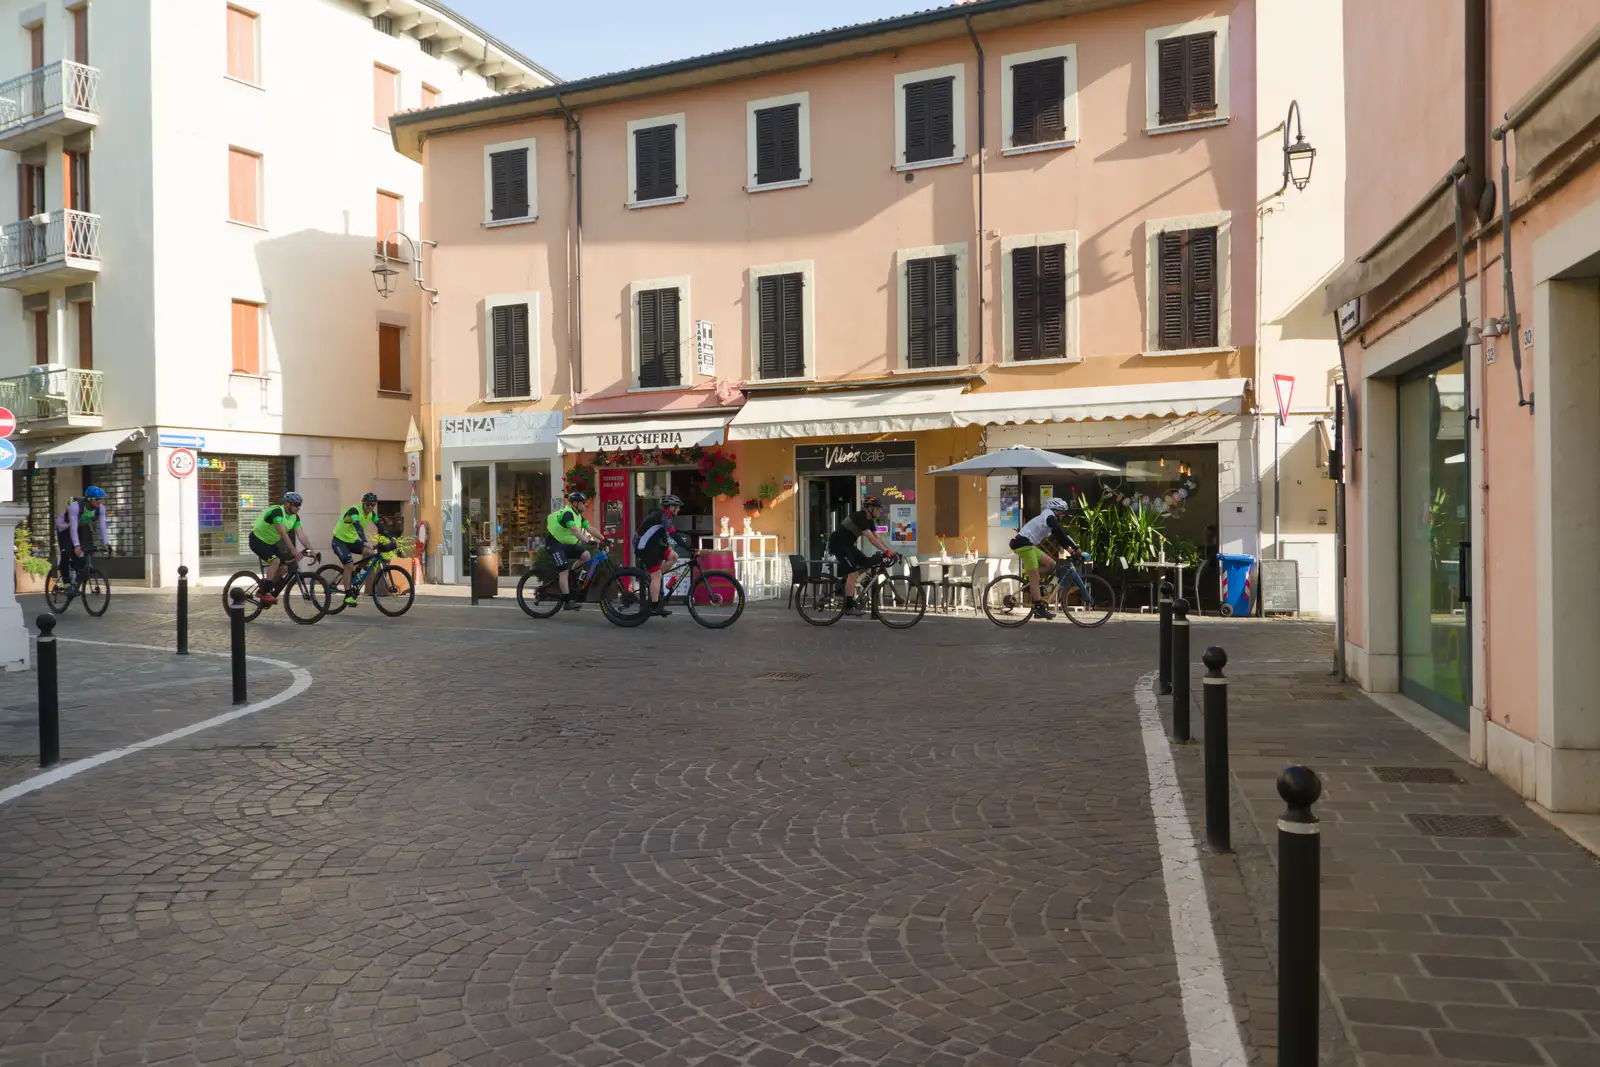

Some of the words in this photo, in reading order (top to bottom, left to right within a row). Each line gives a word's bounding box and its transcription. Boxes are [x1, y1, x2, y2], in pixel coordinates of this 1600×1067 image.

[1524, 329, 1532, 346] 30
[1487, 347, 1494, 362] 32
[446, 417, 495, 434] SENZA
[596, 432, 683, 446] TABACCHERIA
[825, 446, 860, 469] Vibes
